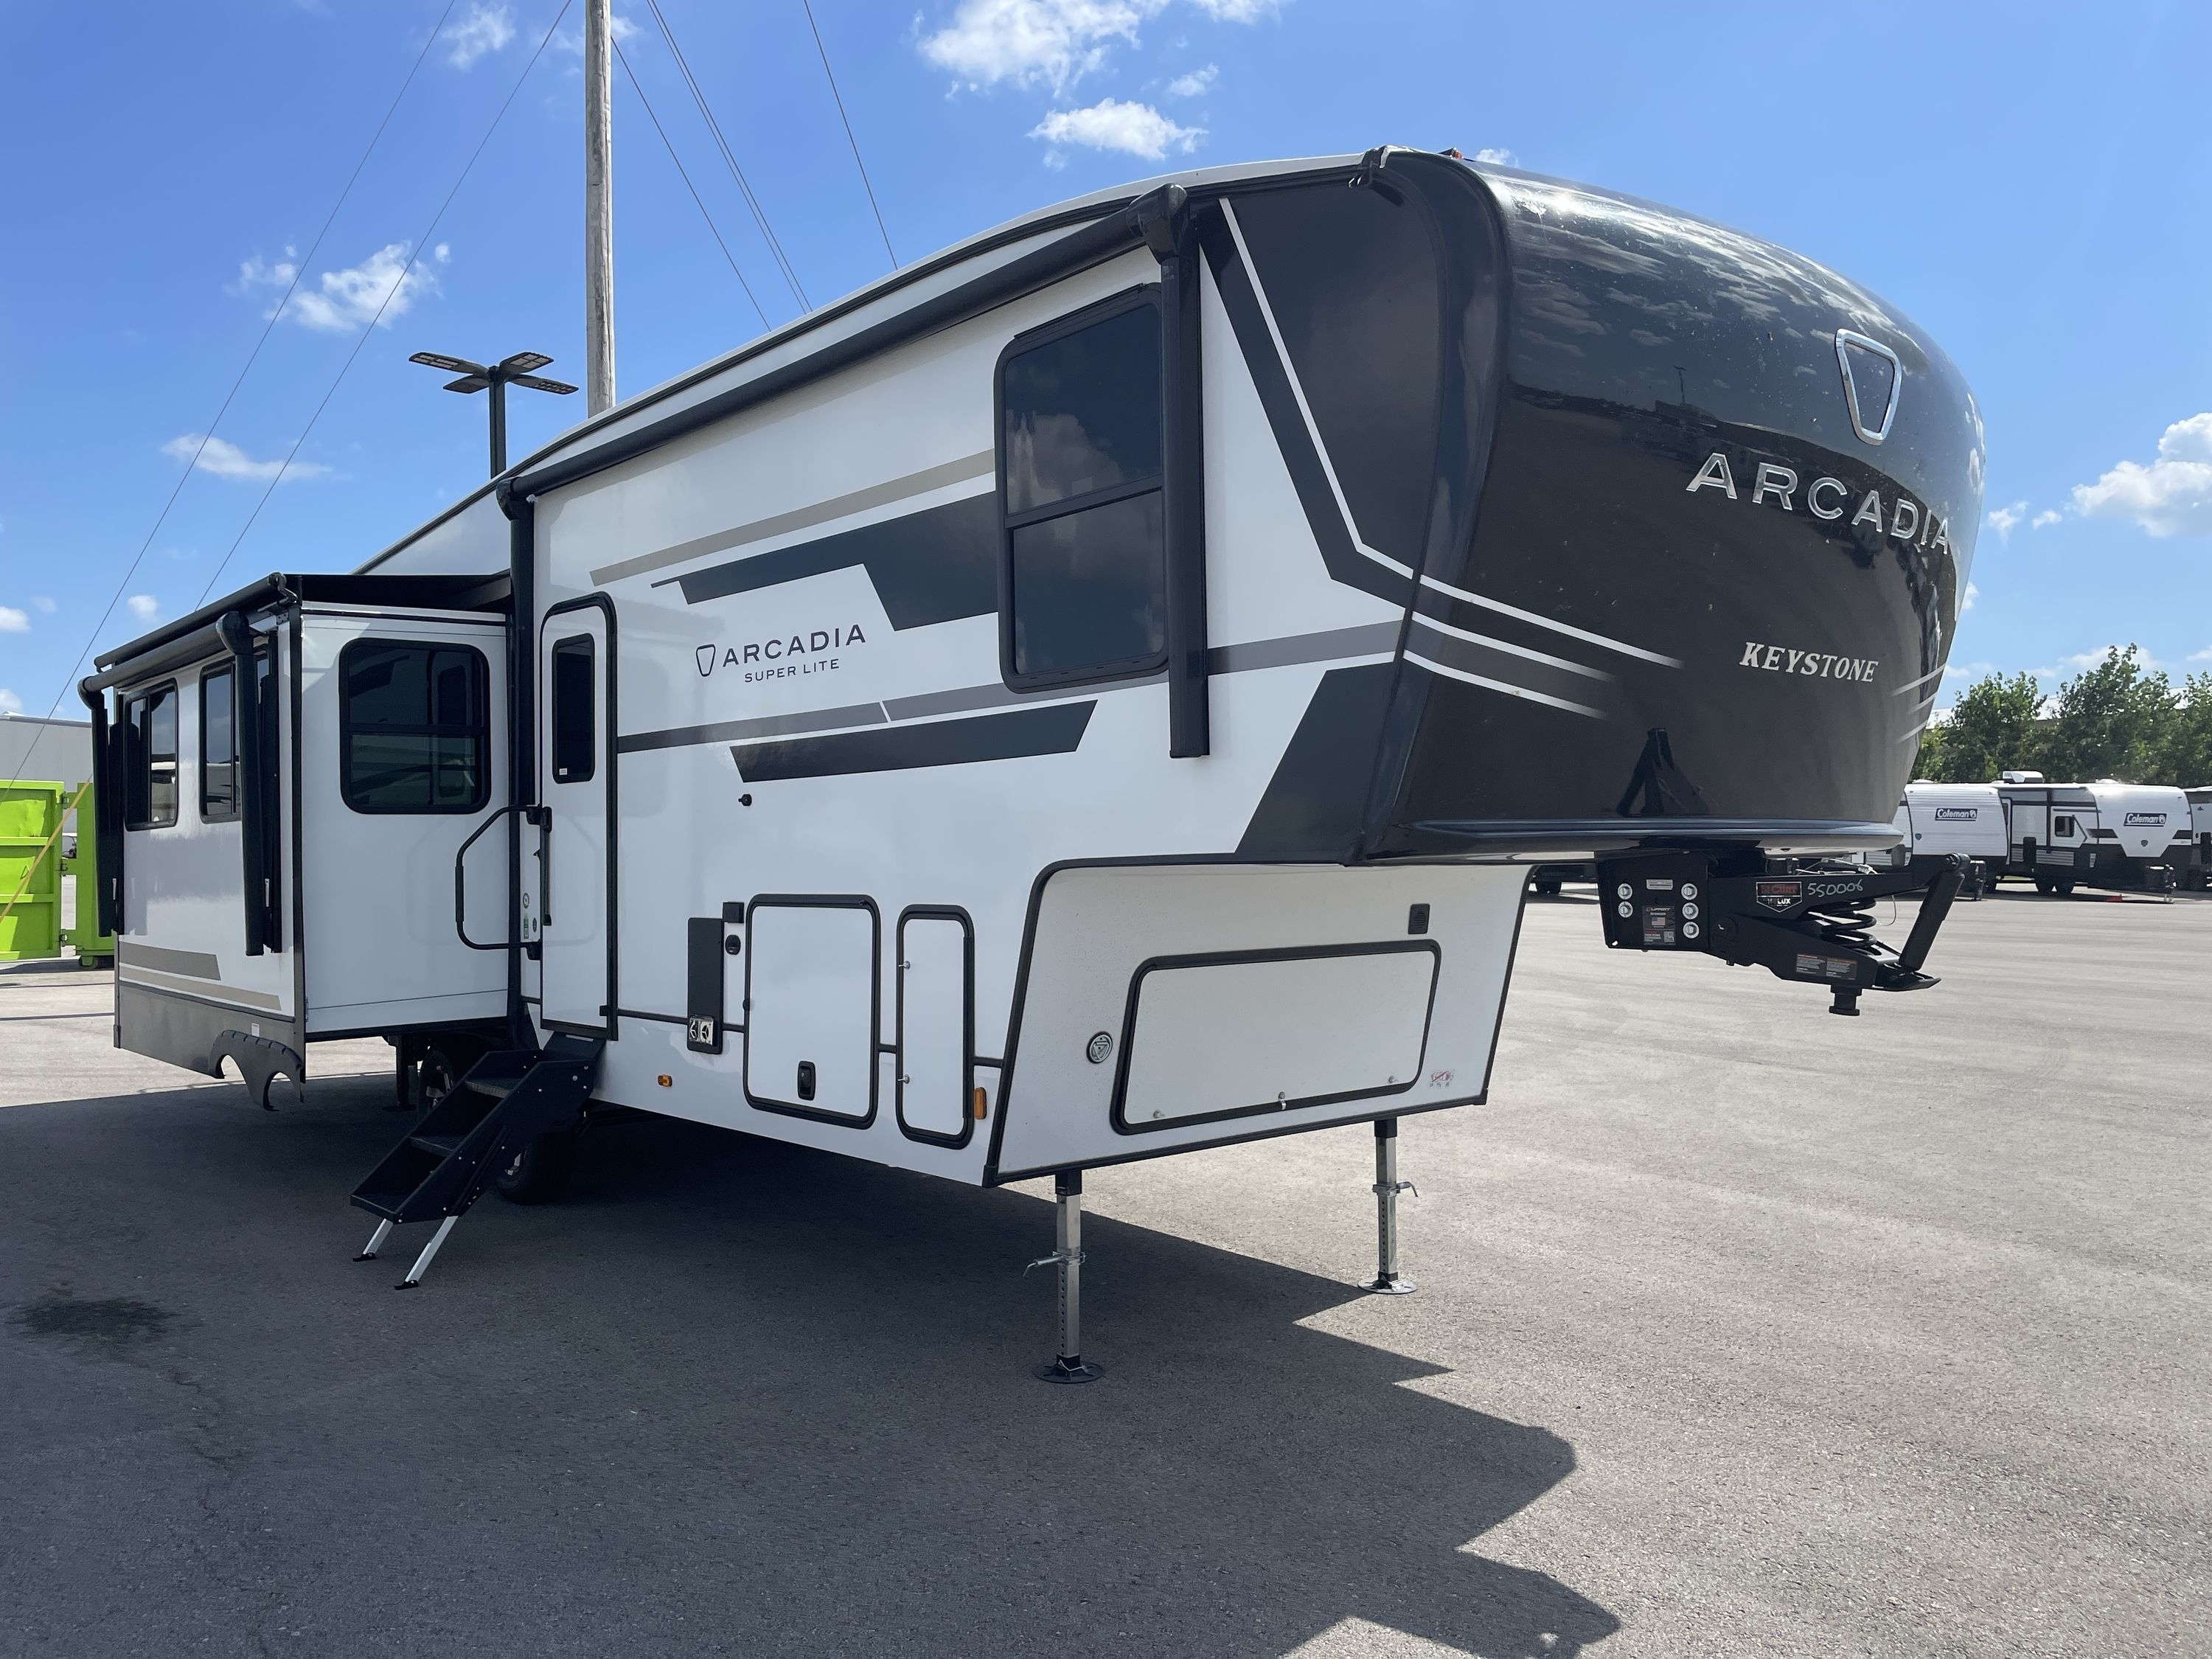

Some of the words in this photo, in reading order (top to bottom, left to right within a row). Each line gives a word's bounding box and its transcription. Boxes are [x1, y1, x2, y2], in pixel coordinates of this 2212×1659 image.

[1686, 452, 1950, 555] ARCADIA
[723, 624, 866, 667] ARCADIA
[1739, 641, 1879, 683] KEYSTONE
[744, 666, 797, 684] SUPER
[803, 658, 841, 675] LITE
[1936, 808, 1969, 819] Coleman
[2126, 813, 2159, 824] Coleman
